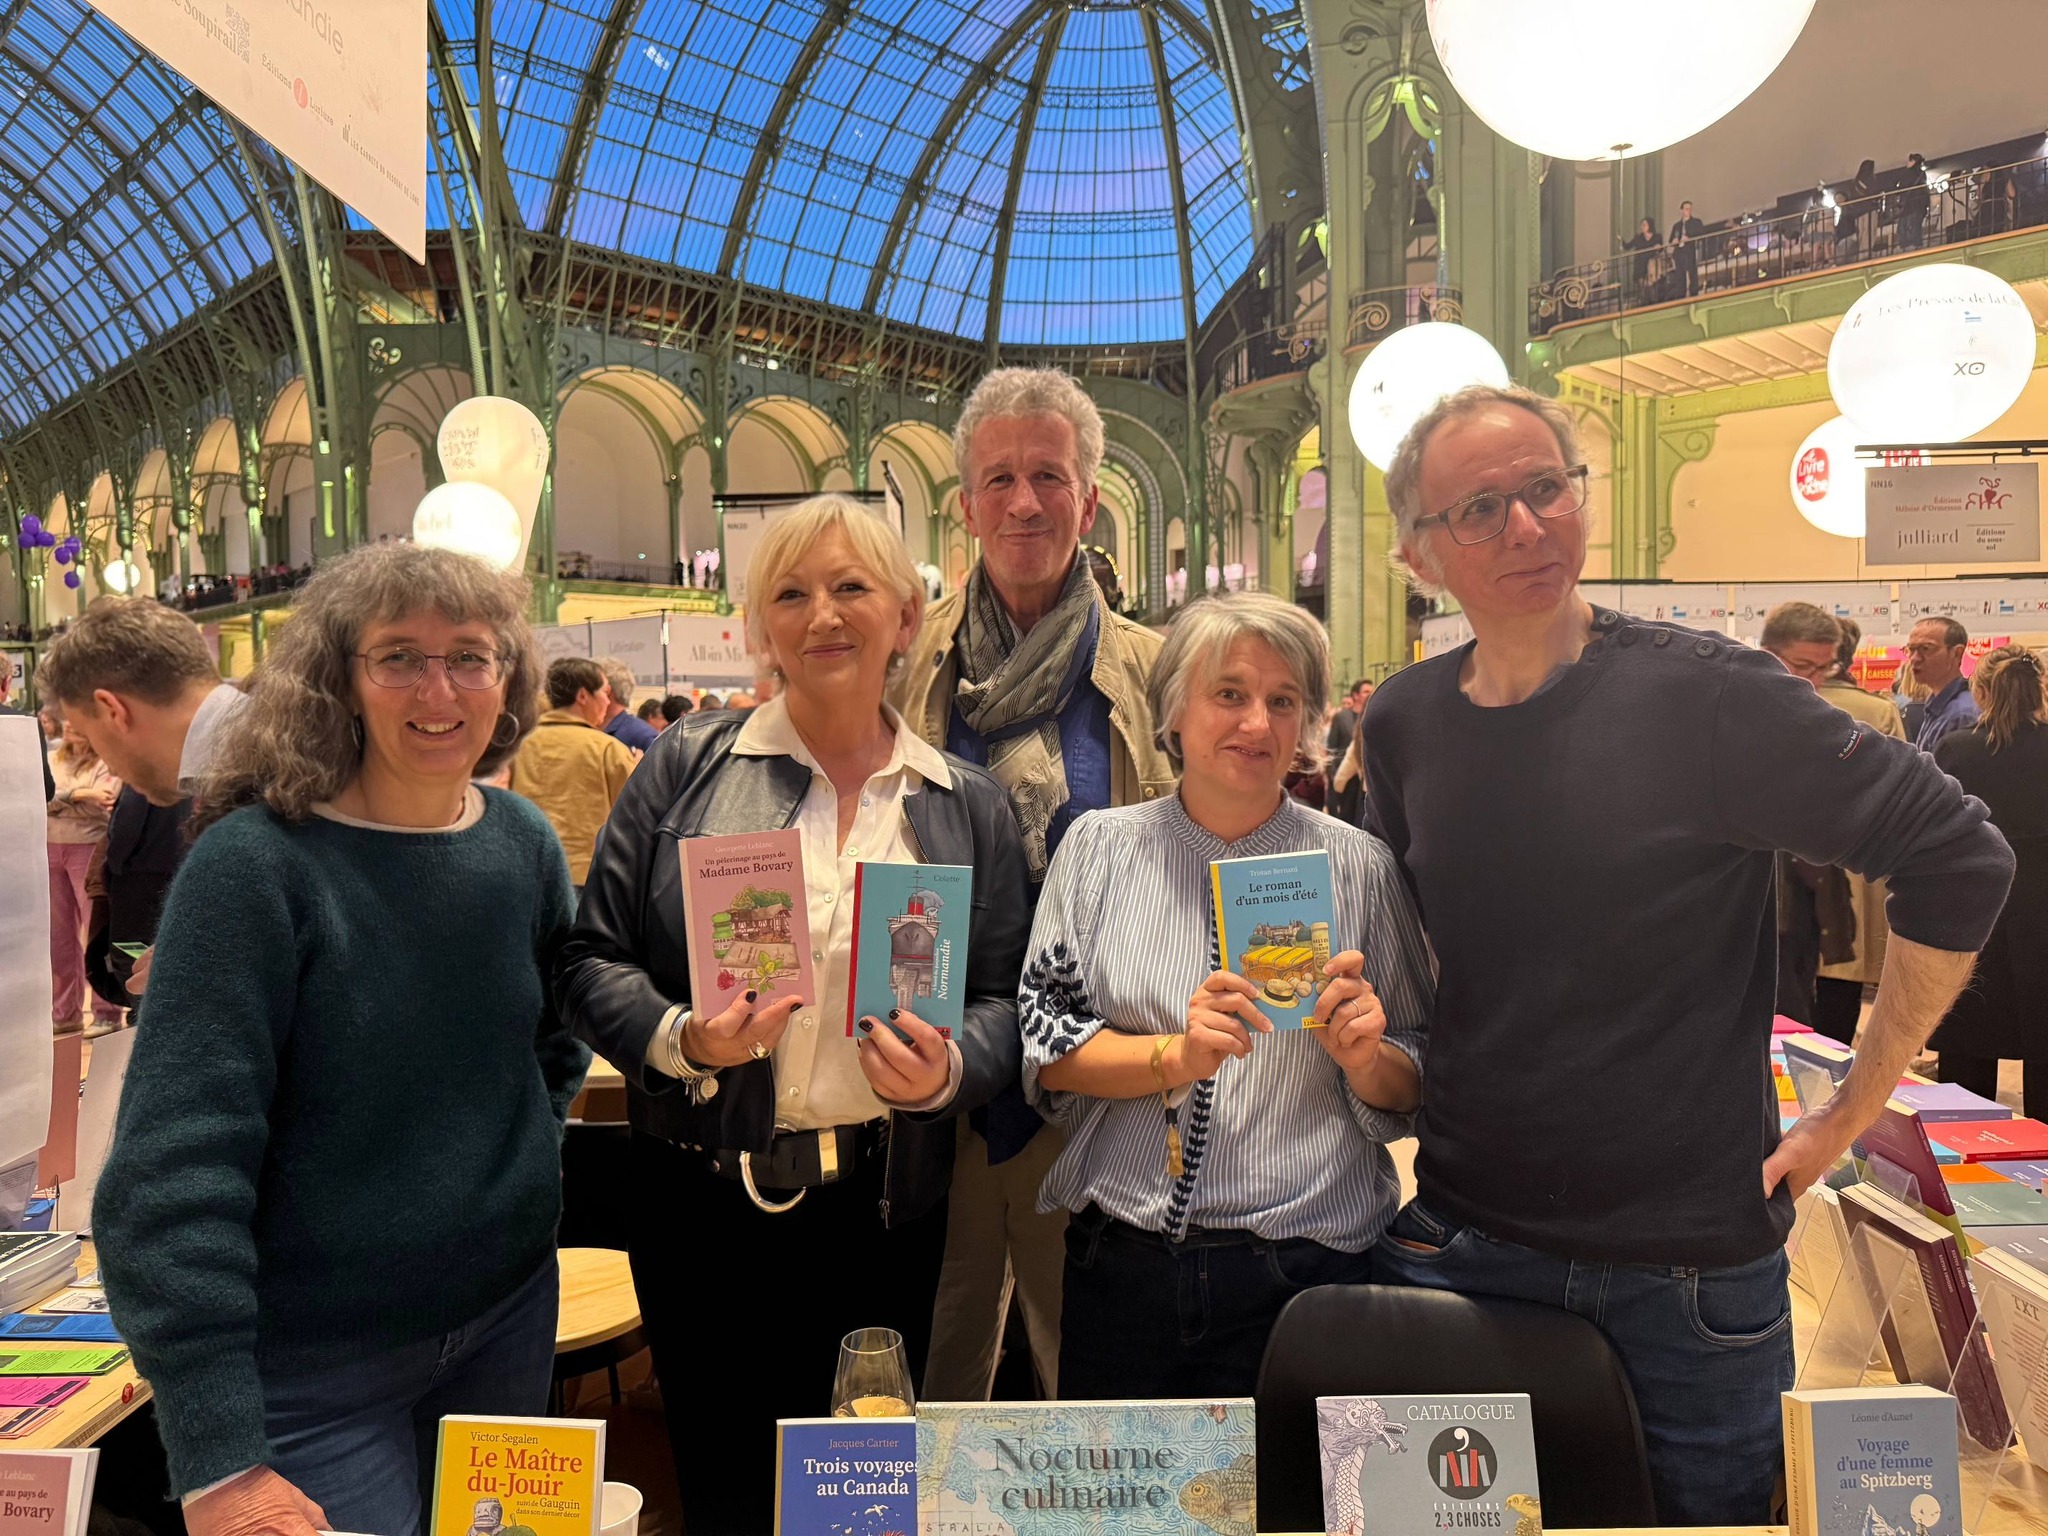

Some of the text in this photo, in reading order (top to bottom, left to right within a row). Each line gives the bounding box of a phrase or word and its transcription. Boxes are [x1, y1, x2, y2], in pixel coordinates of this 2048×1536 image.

[286, 0, 344, 55] andie
[1897, 528, 1959, 550] julliard
[690, 645, 722, 662] Albin
[704, 858, 715, 866] Un
[761, 852, 777, 861] pays
[700, 860, 794, 879] Madame Bovary
[1249, 880, 1302, 893] Le roman
[1235, 888, 1318, 907] d'un mois d'été
[937, 938, 951, 1000] Normandie
[2011, 1294, 2040, 1322] TXT
[1406, 1404, 1515, 1421] CATALOGUE
[1851, 1412, 1914, 1423] Léonie d'Aunet
[470, 1431, 539, 1446] Victor Segalen
[828, 1438, 899, 1451] Jacques Cartier
[1857, 1438, 1910, 1456] Voyage
[468, 1446, 583, 1473] Le Maître
[992, 1437, 1175, 1471] Nocturne
[1837, 1454, 1934, 1472] d'une femme
[4, 1469, 36, 1481] Leblanc
[803, 1456, 850, 1475] Trois
[467, 1469, 564, 1498] du-Jouir
[816, 1477, 910, 1497] au Canada
[1001, 1474, 1166, 1510] culinaire
[1839, 1472, 1934, 1493] au Spitzberg
[6, 1489, 16, 1498] au
[17, 1489, 37, 1501] pays
[38, 1489, 49, 1499] de
[540, 1497, 580, 1511] Gauguin
[3, 1501, 55, 1523] Bovary
[1456, 1511, 1501, 1528] CHOSES
